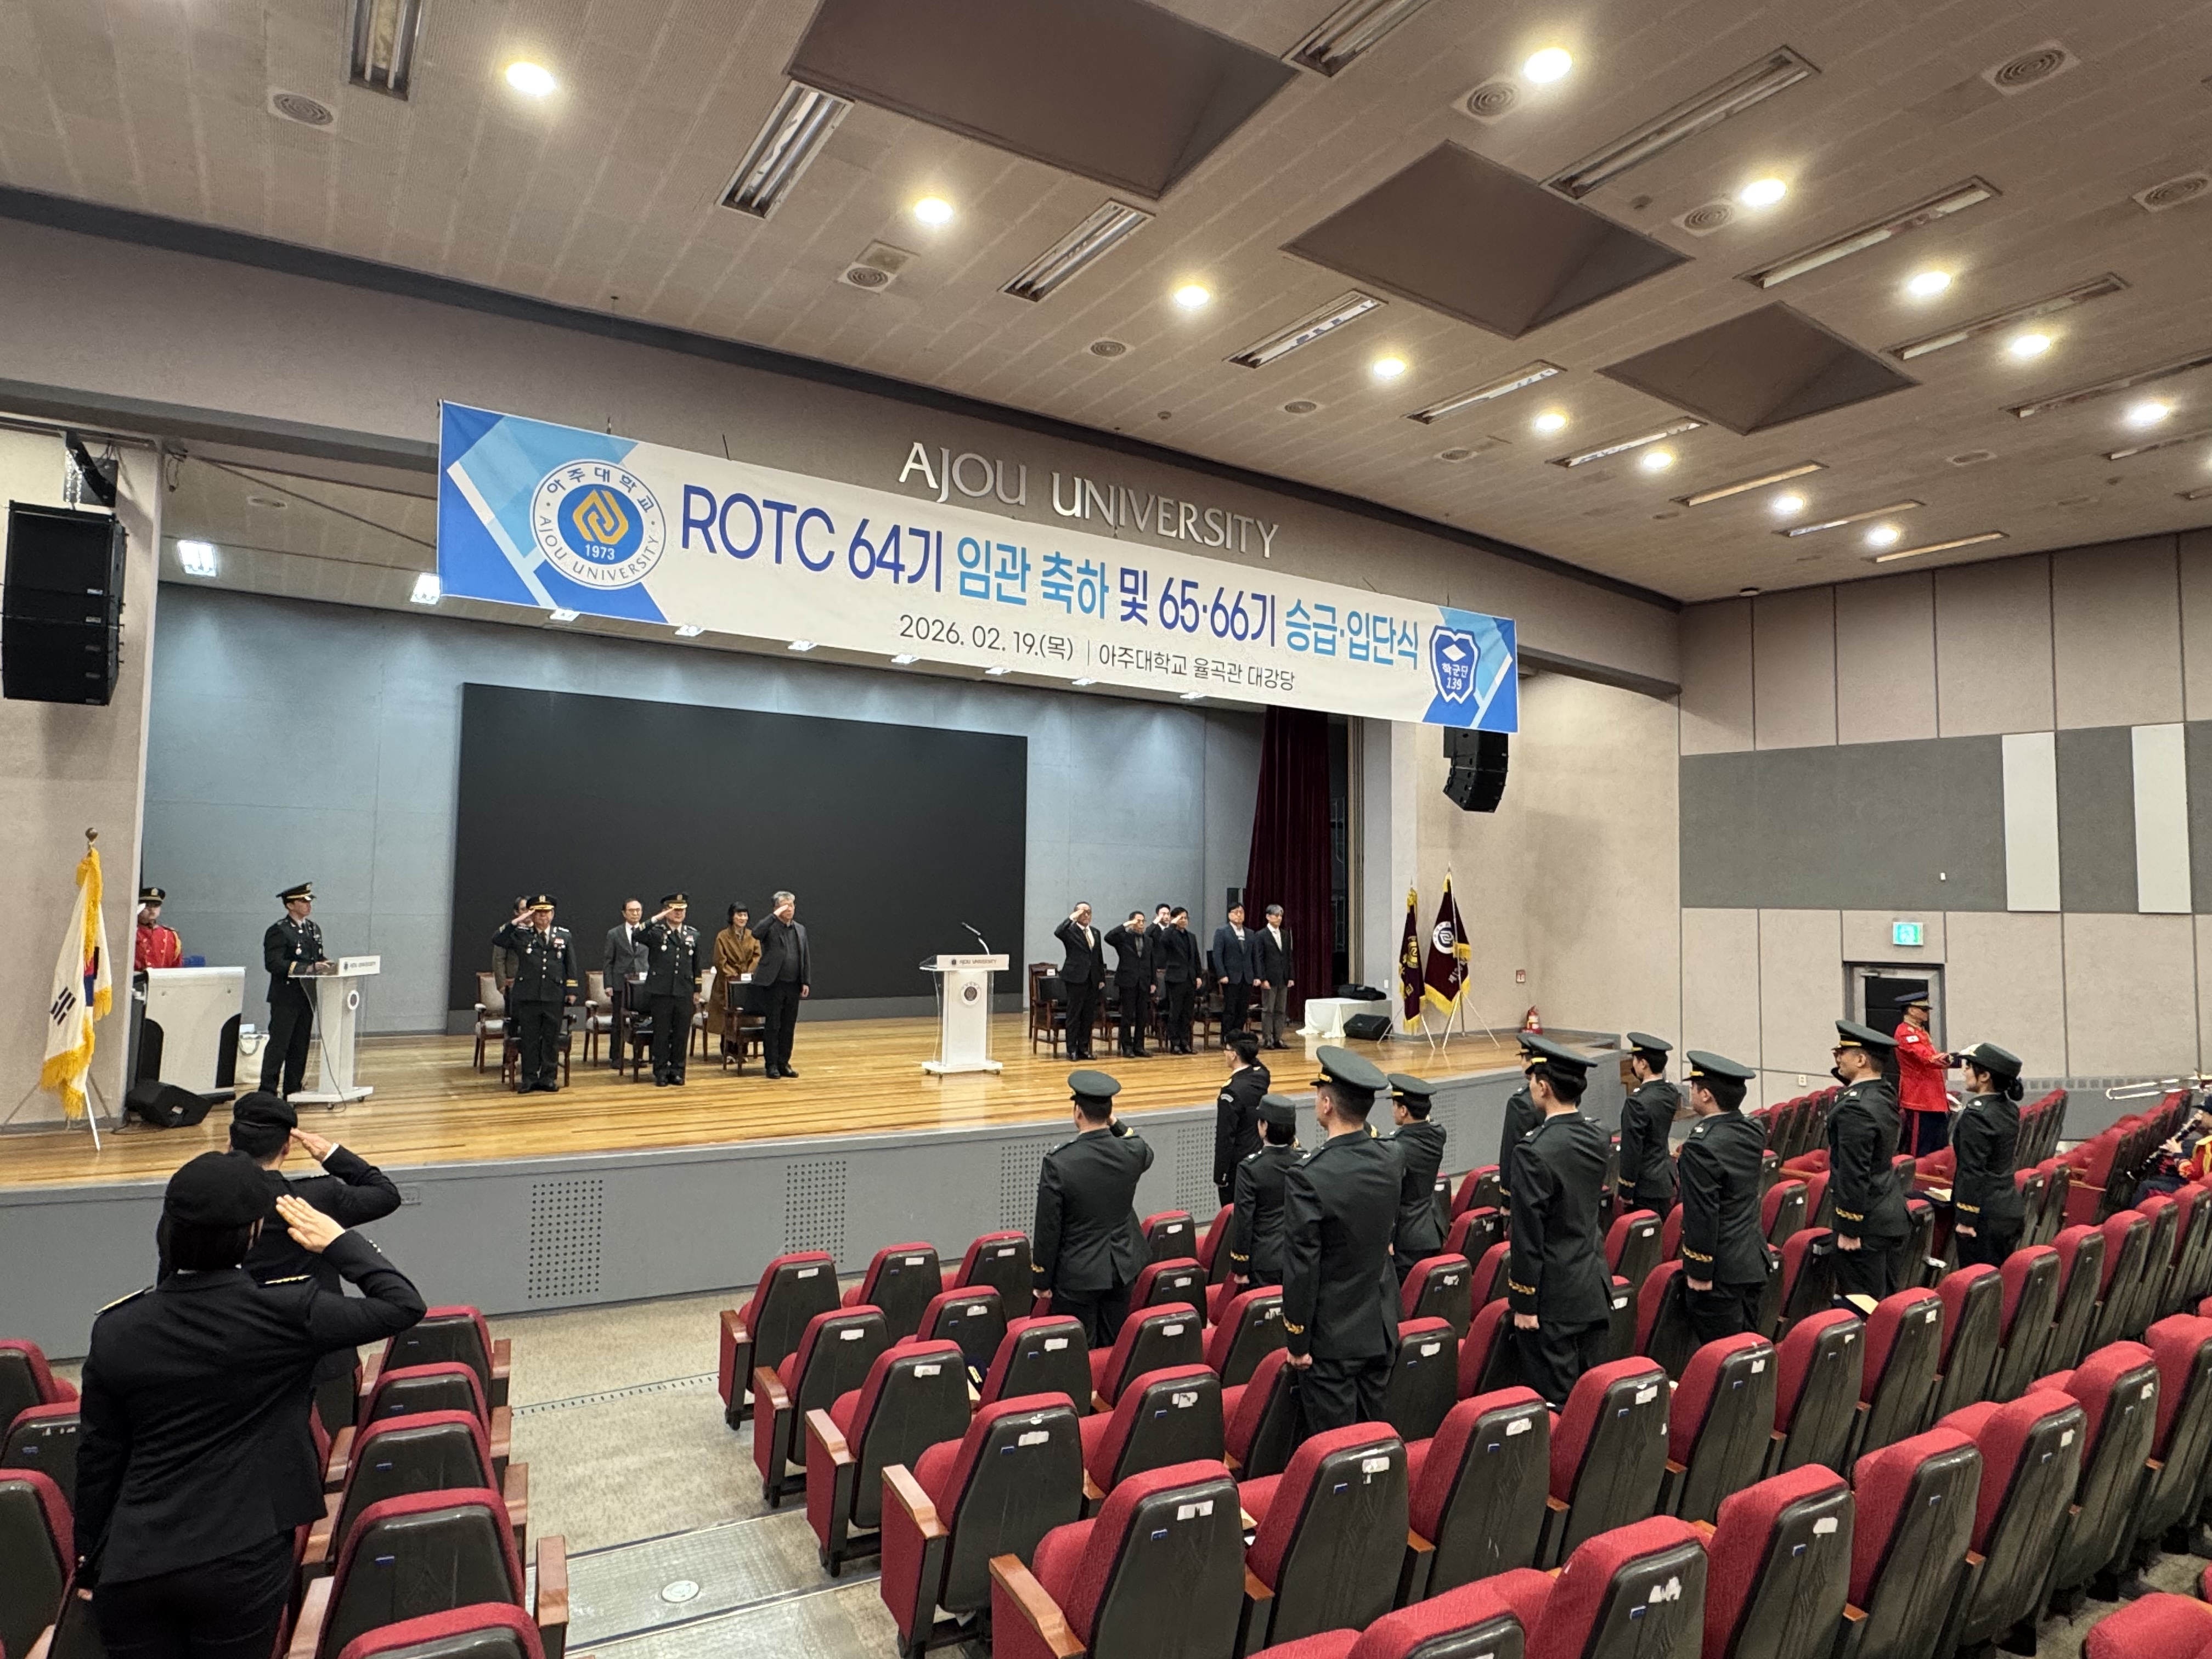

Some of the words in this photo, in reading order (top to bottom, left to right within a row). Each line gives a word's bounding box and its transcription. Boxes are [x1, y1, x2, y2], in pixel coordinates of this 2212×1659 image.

[547, 467, 654, 512] 아주대학교
[899, 442, 1027, 505] AJOU
[1052, 472, 1279, 558] UNIVERSITY
[538, 516, 567, 560] AJOU
[573, 535, 659, 580] UNIVERSITY
[585, 544, 616, 561] 1973
[682, 483, 836, 572] ROTC
[848, 518, 943, 592] 64기
[957, 537, 1031, 606] 임관
[1041, 551, 1109, 619] 축하
[1120, 566, 1148, 626] 및
[900, 614, 964, 646] 2026.
[972, 625, 1006, 652] 02.
[1013, 631, 1074, 661] 19.(목)
[1099, 644, 1188, 676] 아주대학교
[1193, 657, 1243, 685] 율곡관
[1248, 666, 1295, 692] 대강당
[1446, 677, 1463, 691] 139
